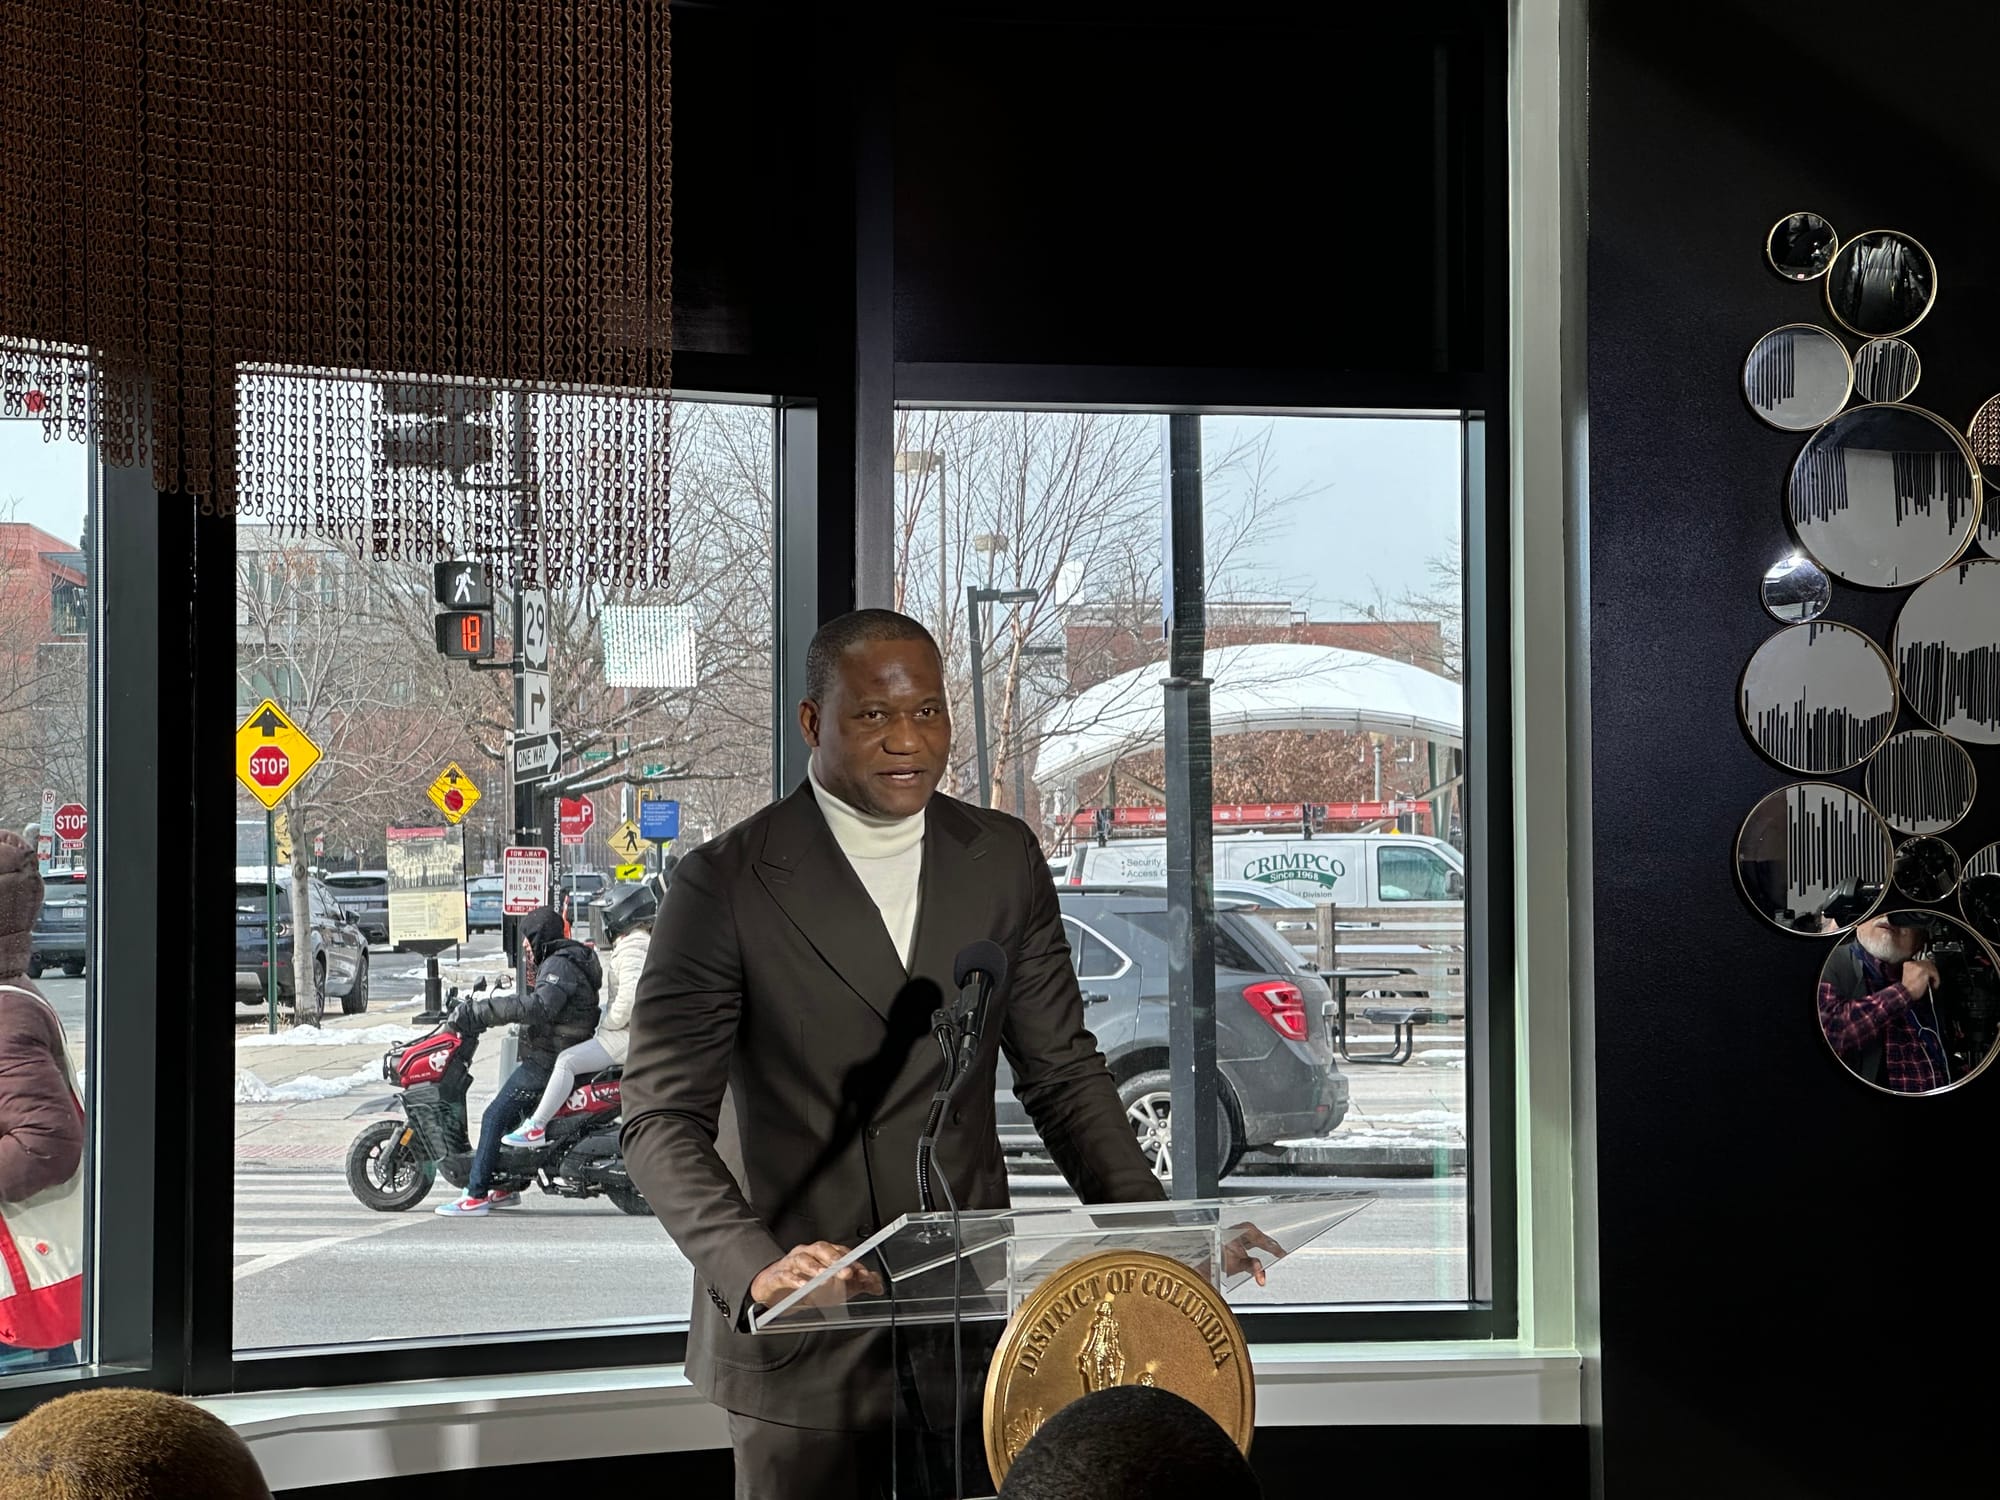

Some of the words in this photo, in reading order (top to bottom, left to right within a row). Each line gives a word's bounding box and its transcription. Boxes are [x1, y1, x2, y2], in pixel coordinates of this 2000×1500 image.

[526, 601, 545, 648] 29
[461, 615, 480, 652] 18
[519, 750, 531, 768] ONE
[533, 745, 547, 764] WAY
[251, 758, 288, 775] STOP
[56, 815, 88, 830] STOP
[509, 867, 516, 875] OR
[517, 867, 543, 875] PARKING
[1126, 858, 1161, 868] Security
[1243, 853, 1346, 880] CRIMPCO
[1126, 870, 1158, 878] Access
[1270, 872, 1295, 882] Since
[1297, 871, 1319, 881] 1968
[1018, 1274, 1100, 1378] DISTRICT
[1105, 1268, 1138, 1295] OF
[1141, 1270, 1234, 1371] COLUMBIA
